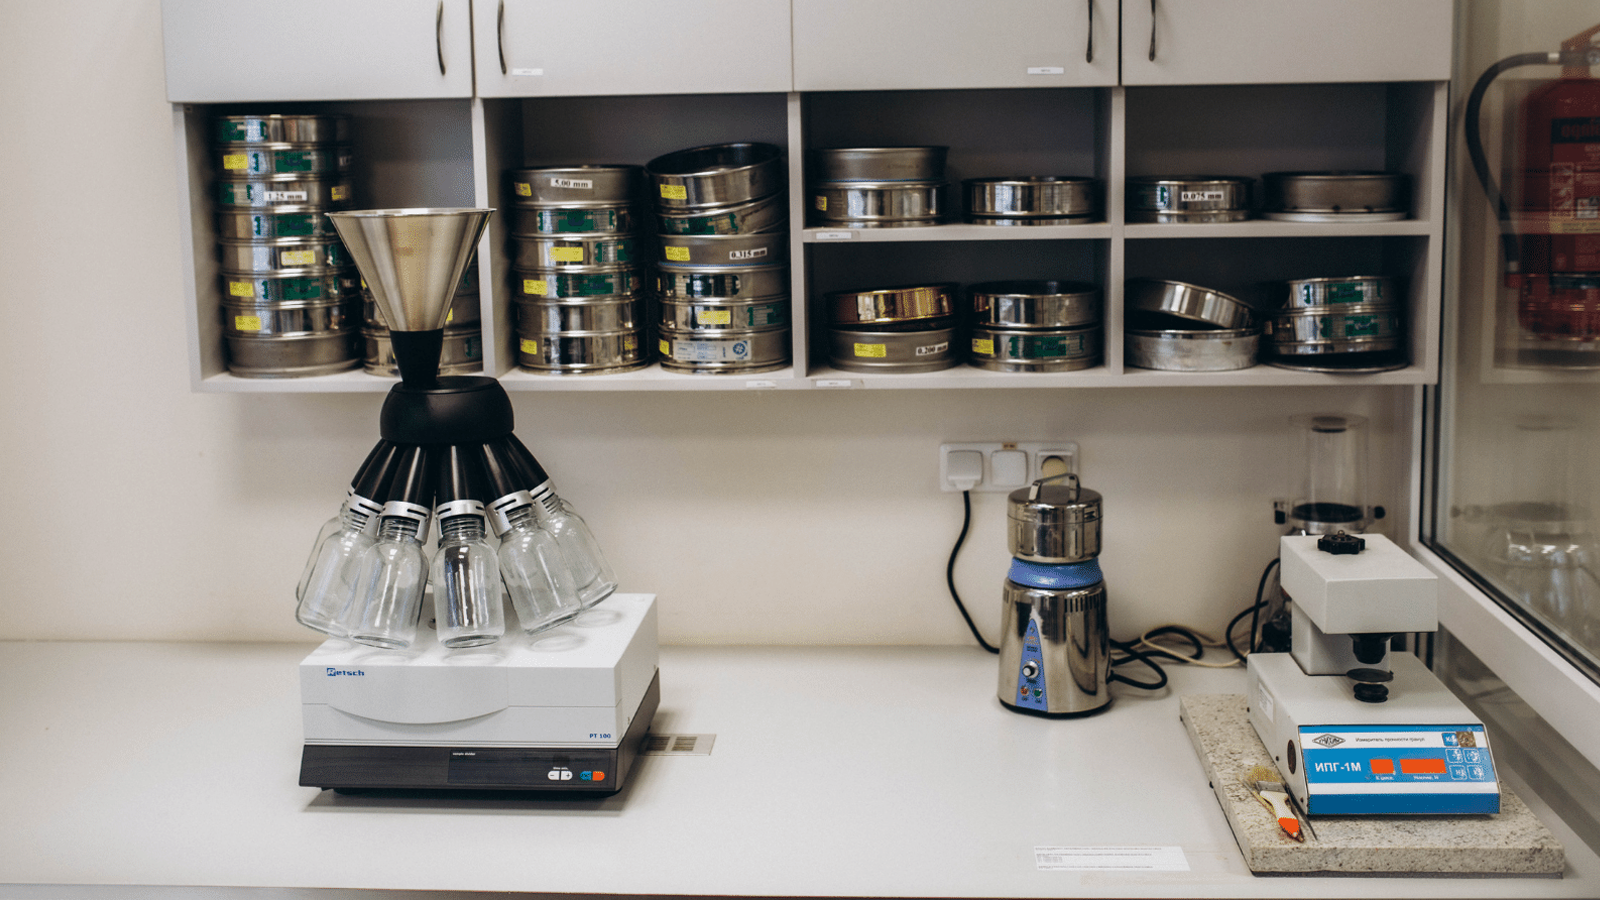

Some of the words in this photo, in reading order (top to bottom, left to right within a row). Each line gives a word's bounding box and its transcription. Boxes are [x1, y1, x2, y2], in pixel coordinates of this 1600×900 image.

[554, 179, 571, 187] 5.00
[267, 192, 285, 200] 1.25
[1183, 192, 1206, 200] 0.075
[731, 250, 751, 258] 0.315
[326, 667, 365, 676] Retsch
[1315, 762, 1361, 772] ИПГ-1М
